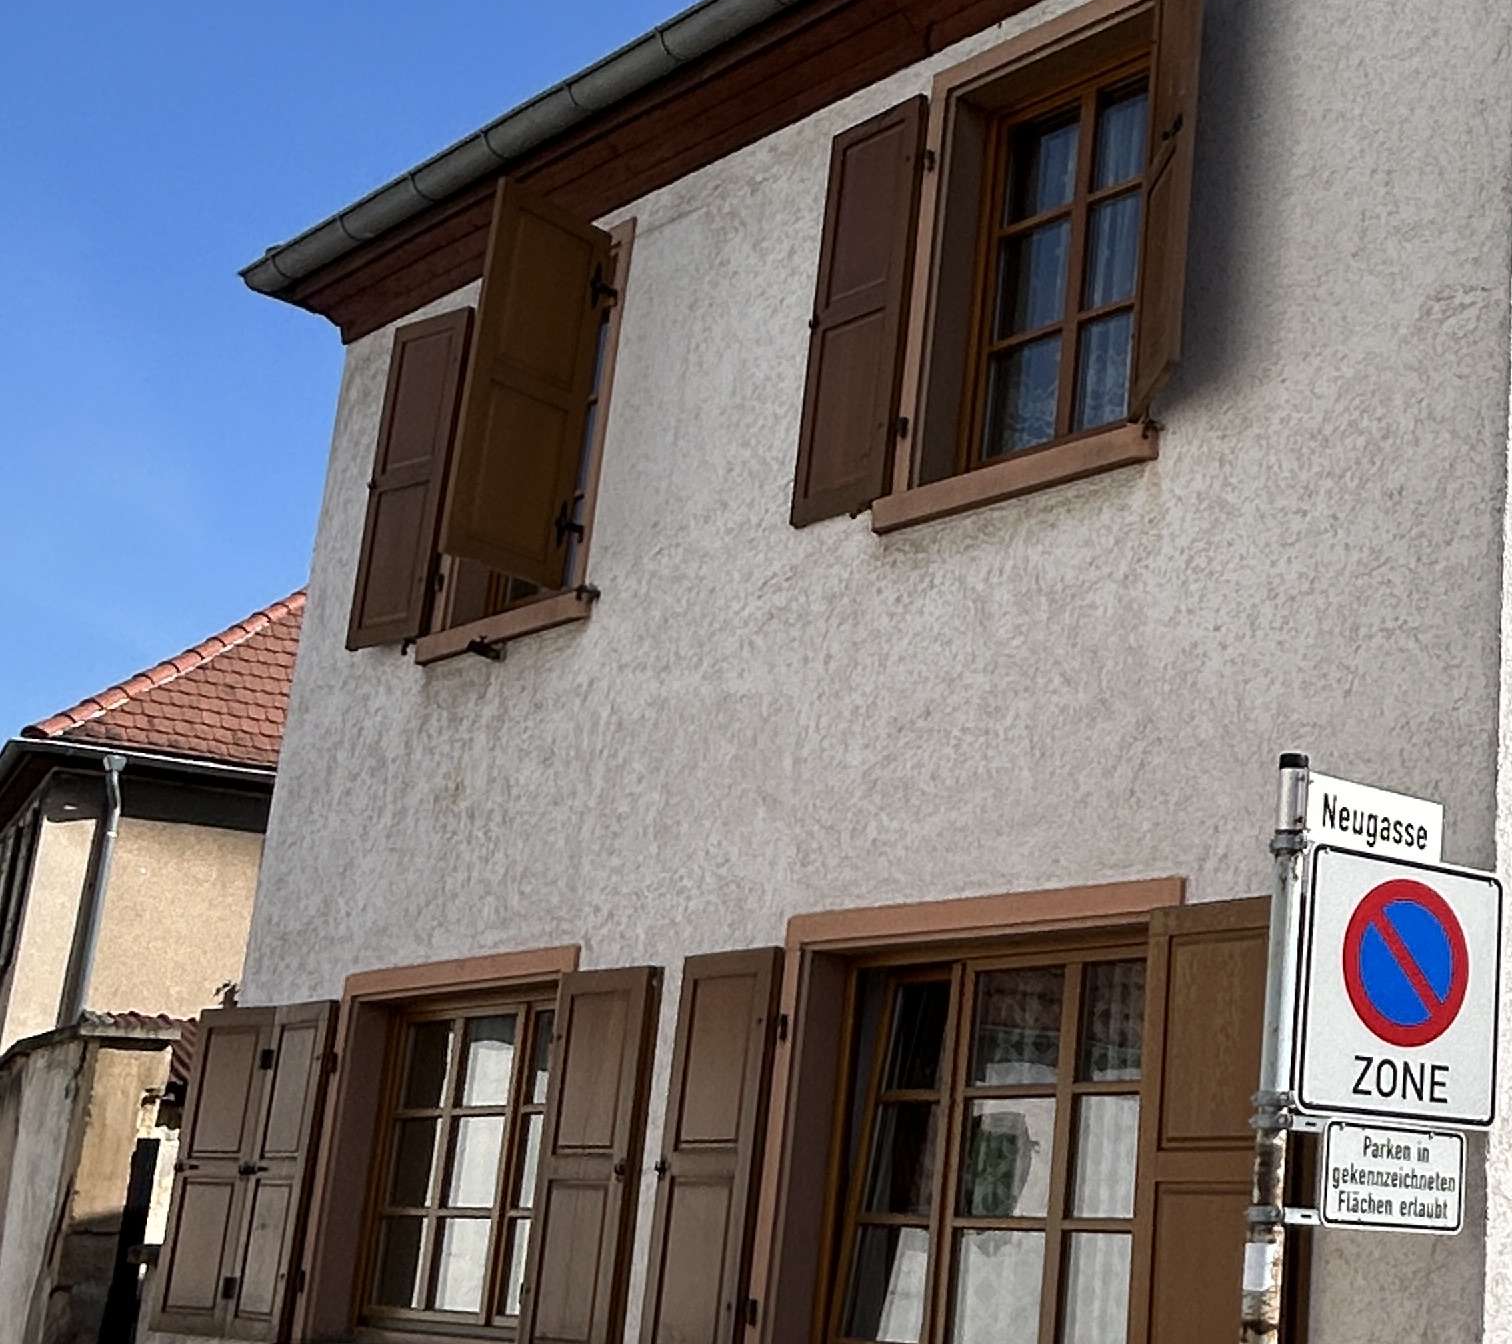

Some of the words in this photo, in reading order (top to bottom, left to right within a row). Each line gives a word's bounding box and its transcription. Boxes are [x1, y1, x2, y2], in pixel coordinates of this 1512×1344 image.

[1322, 792, 1428, 850] Neugasse
[1352, 1054, 1450, 1104] ZONE
[1363, 1135, 1411, 1161] Parken
[1416, 1140, 1430, 1163] in
[1332, 1162, 1456, 1192] gekennzeichneten
[1338, 1190, 1393, 1216] Flächen
[1400, 1196, 1448, 1220] erlaubt
